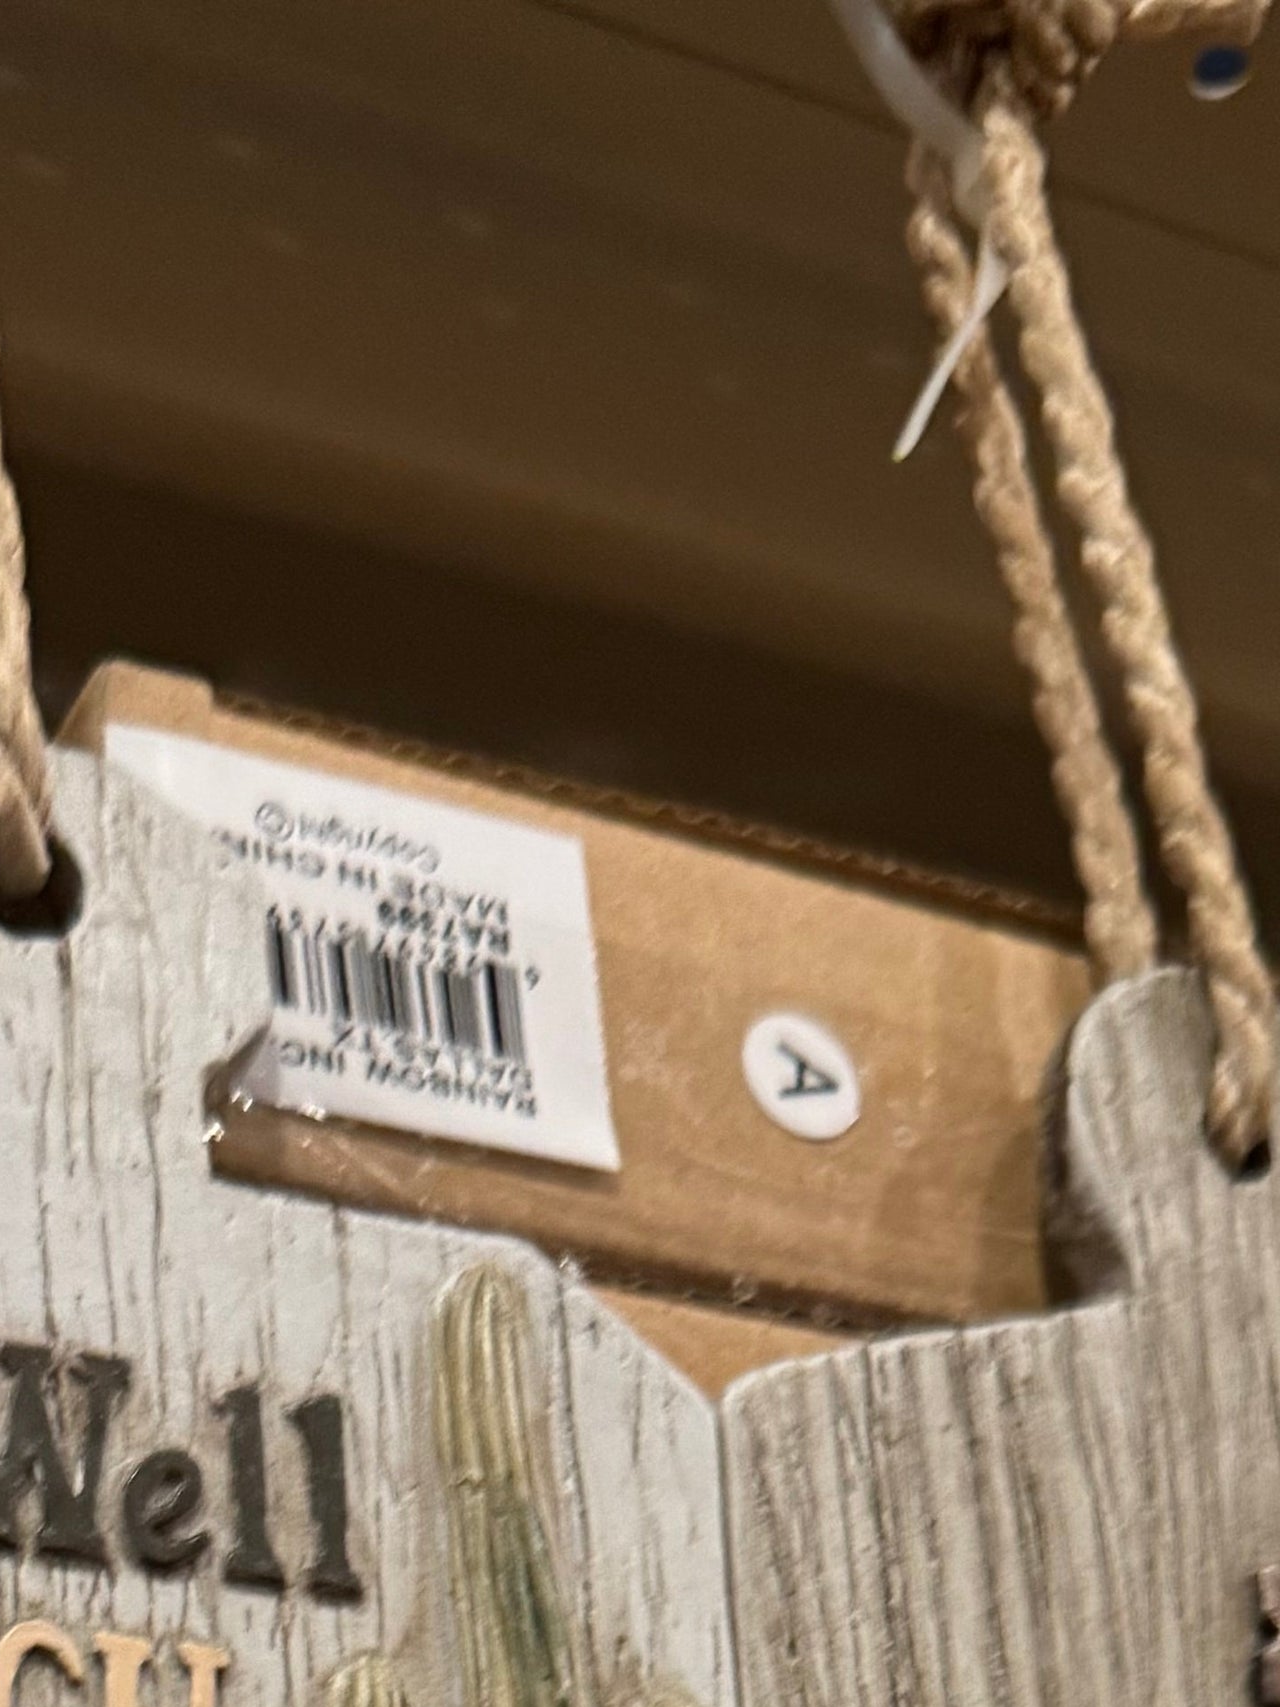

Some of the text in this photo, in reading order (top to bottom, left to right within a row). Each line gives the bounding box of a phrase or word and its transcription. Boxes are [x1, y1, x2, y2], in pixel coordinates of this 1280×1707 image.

[211, 826, 510, 927] MADE IN CHIN
[777, 1041, 839, 1101] A
